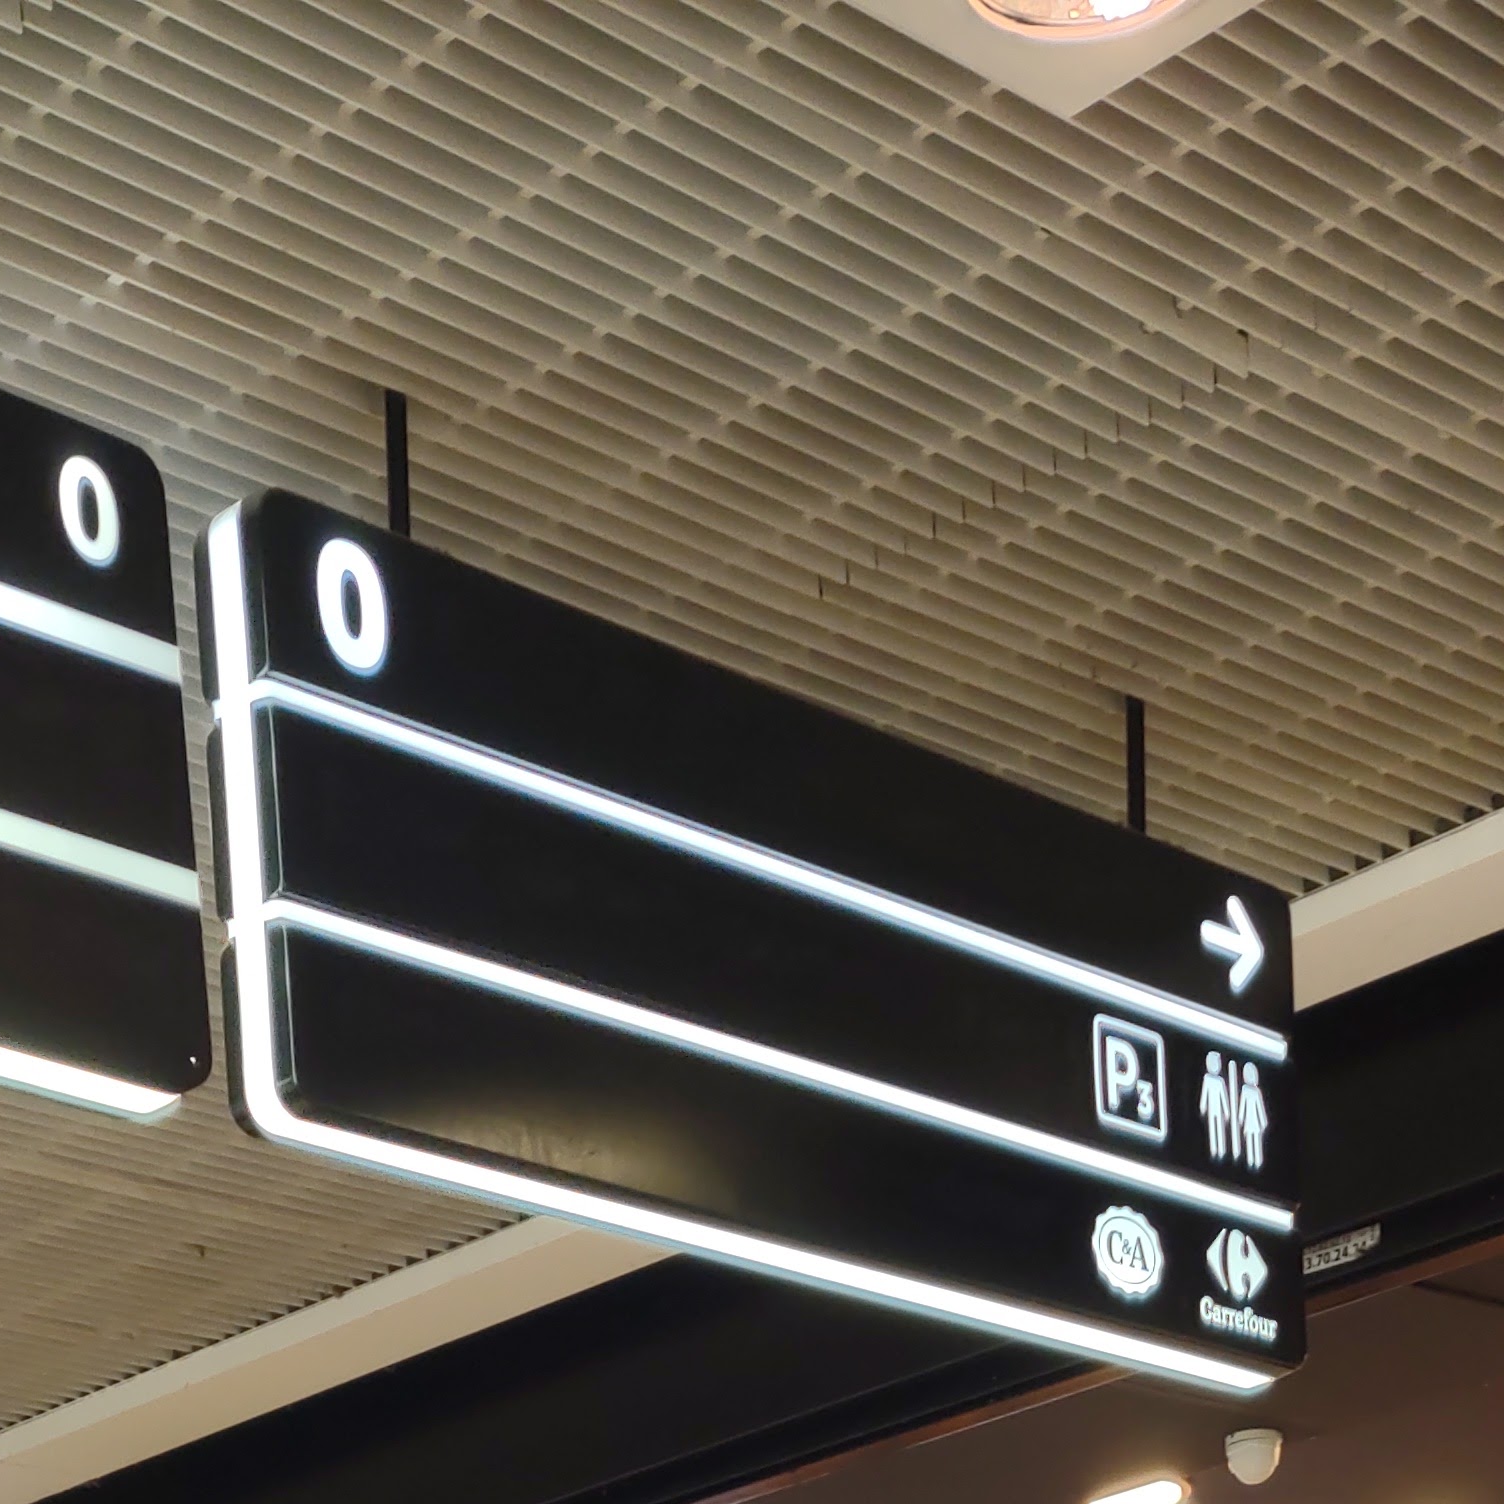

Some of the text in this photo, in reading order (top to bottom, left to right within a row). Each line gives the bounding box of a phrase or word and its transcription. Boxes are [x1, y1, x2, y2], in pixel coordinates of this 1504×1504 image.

[59, 454, 119, 568] 0
[316, 538, 390, 677] 0
[1107, 1217, 1150, 1273] C&A
[1200, 1295, 1278, 1341] Carrefour
